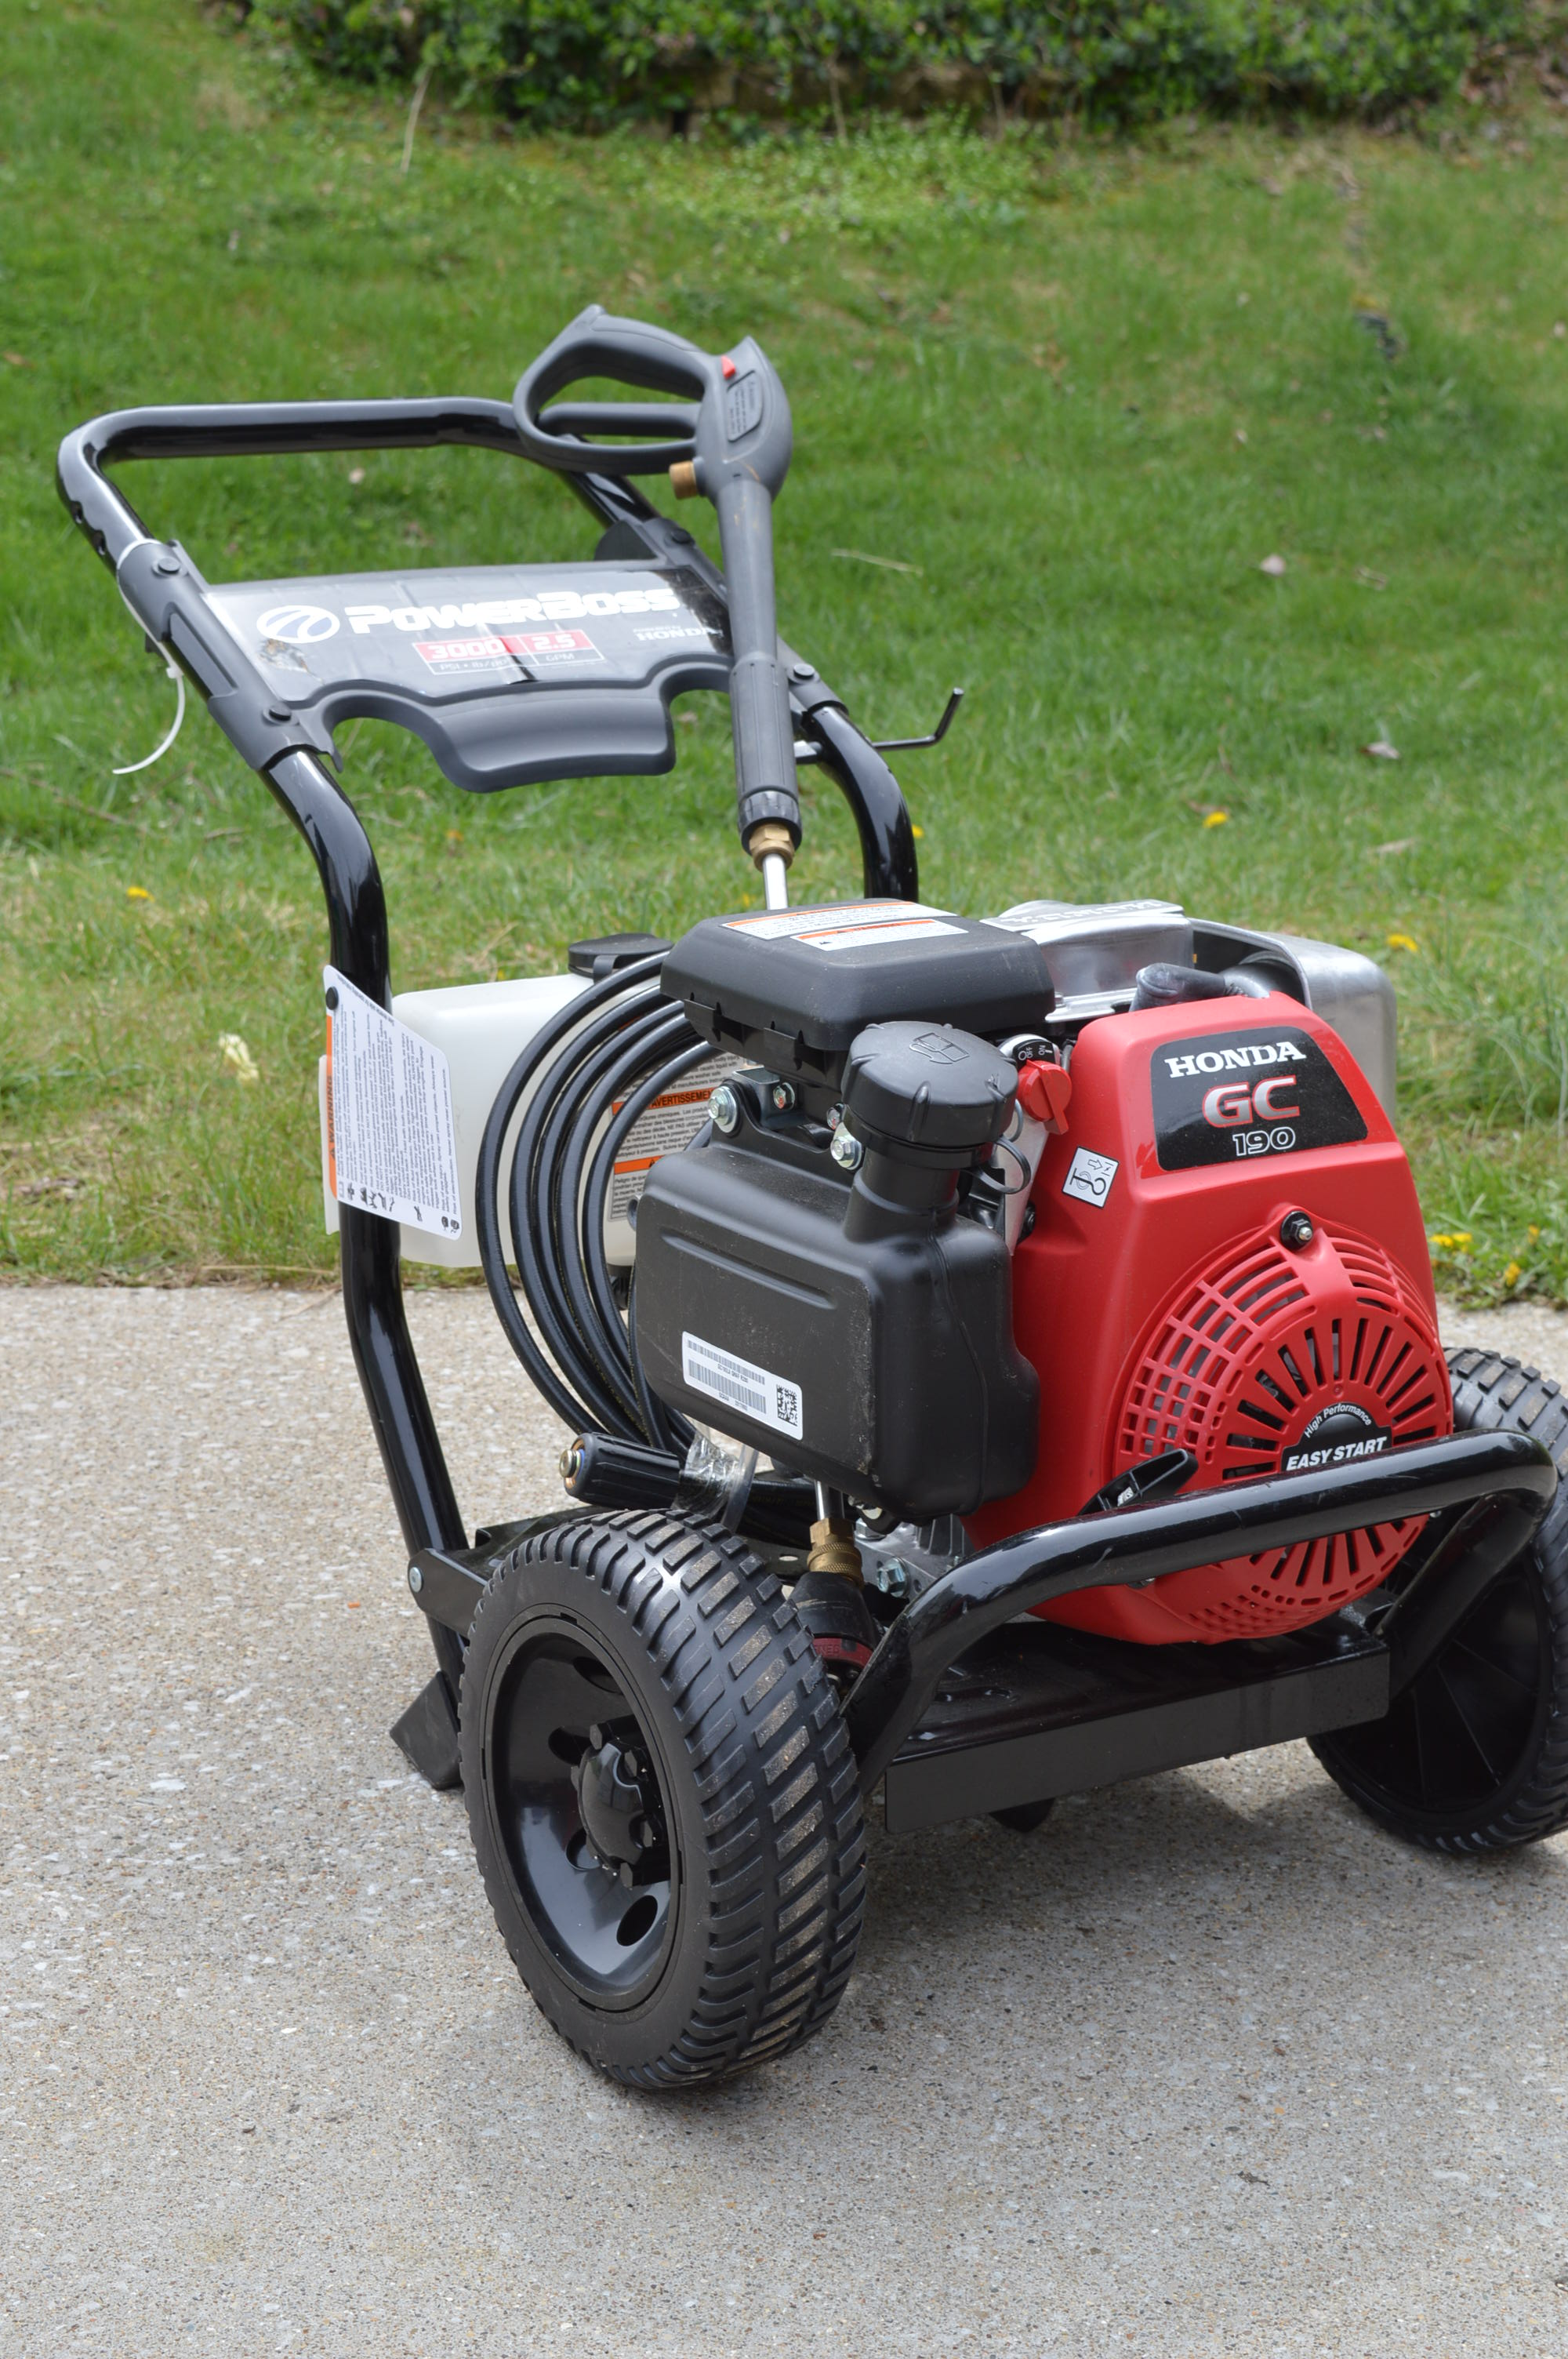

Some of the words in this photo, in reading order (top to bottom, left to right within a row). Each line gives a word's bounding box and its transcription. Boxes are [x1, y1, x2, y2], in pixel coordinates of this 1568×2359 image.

[427, 638, 506, 660] 3000
[532, 632, 576, 650] 2.5
[636, 627, 717, 642] HONDA
[546, 652, 574, 663] GPM
[1164, 1041, 1307, 1078] HONDA
[652, 1089, 713, 1107] AVERTISSEMEN
[1202, 1074, 1300, 1128] GC
[1232, 1126, 1296, 1157] 190
[1304, 1415, 1323, 1438] High
[1323, 1402, 1372, 1426] Performance
[1286, 1448, 1333, 1471] EASY
[1333, 1436, 1388, 1460] START
